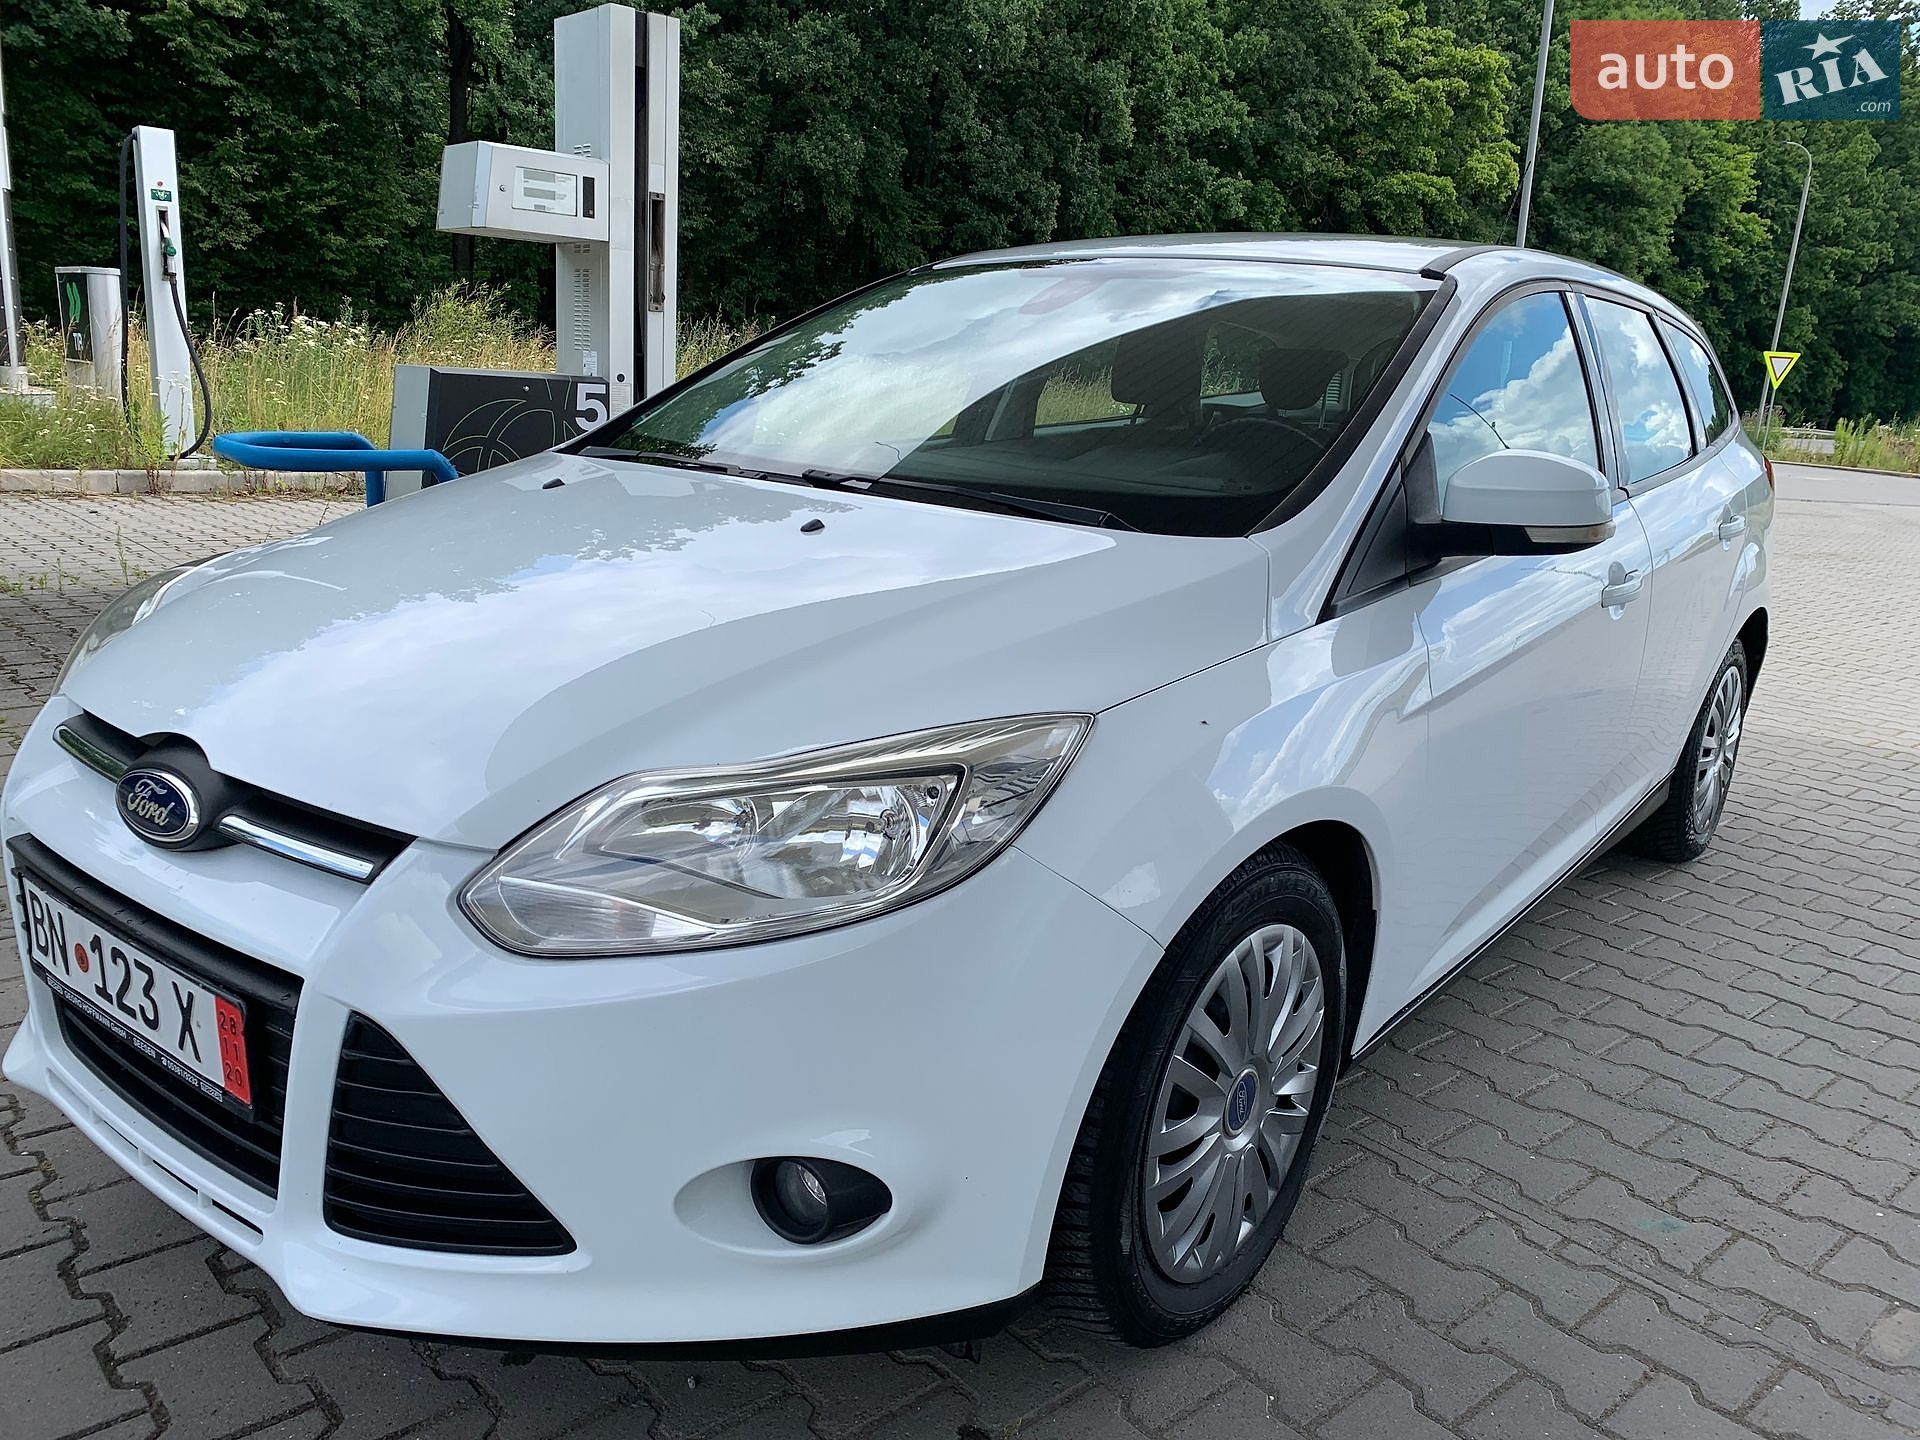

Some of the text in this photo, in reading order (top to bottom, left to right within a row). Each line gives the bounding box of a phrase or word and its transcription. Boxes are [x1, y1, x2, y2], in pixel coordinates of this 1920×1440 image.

[575, 383, 608, 431] 5
[127, 778, 176, 826] Ford
[28, 888, 202, 1063] BN 123 X
[219, 1010, 237, 1036] 28
[223, 1036, 239, 1061] 11
[225, 1061, 244, 1088] 20
[1238, 1090, 1246, 1113] Ford
